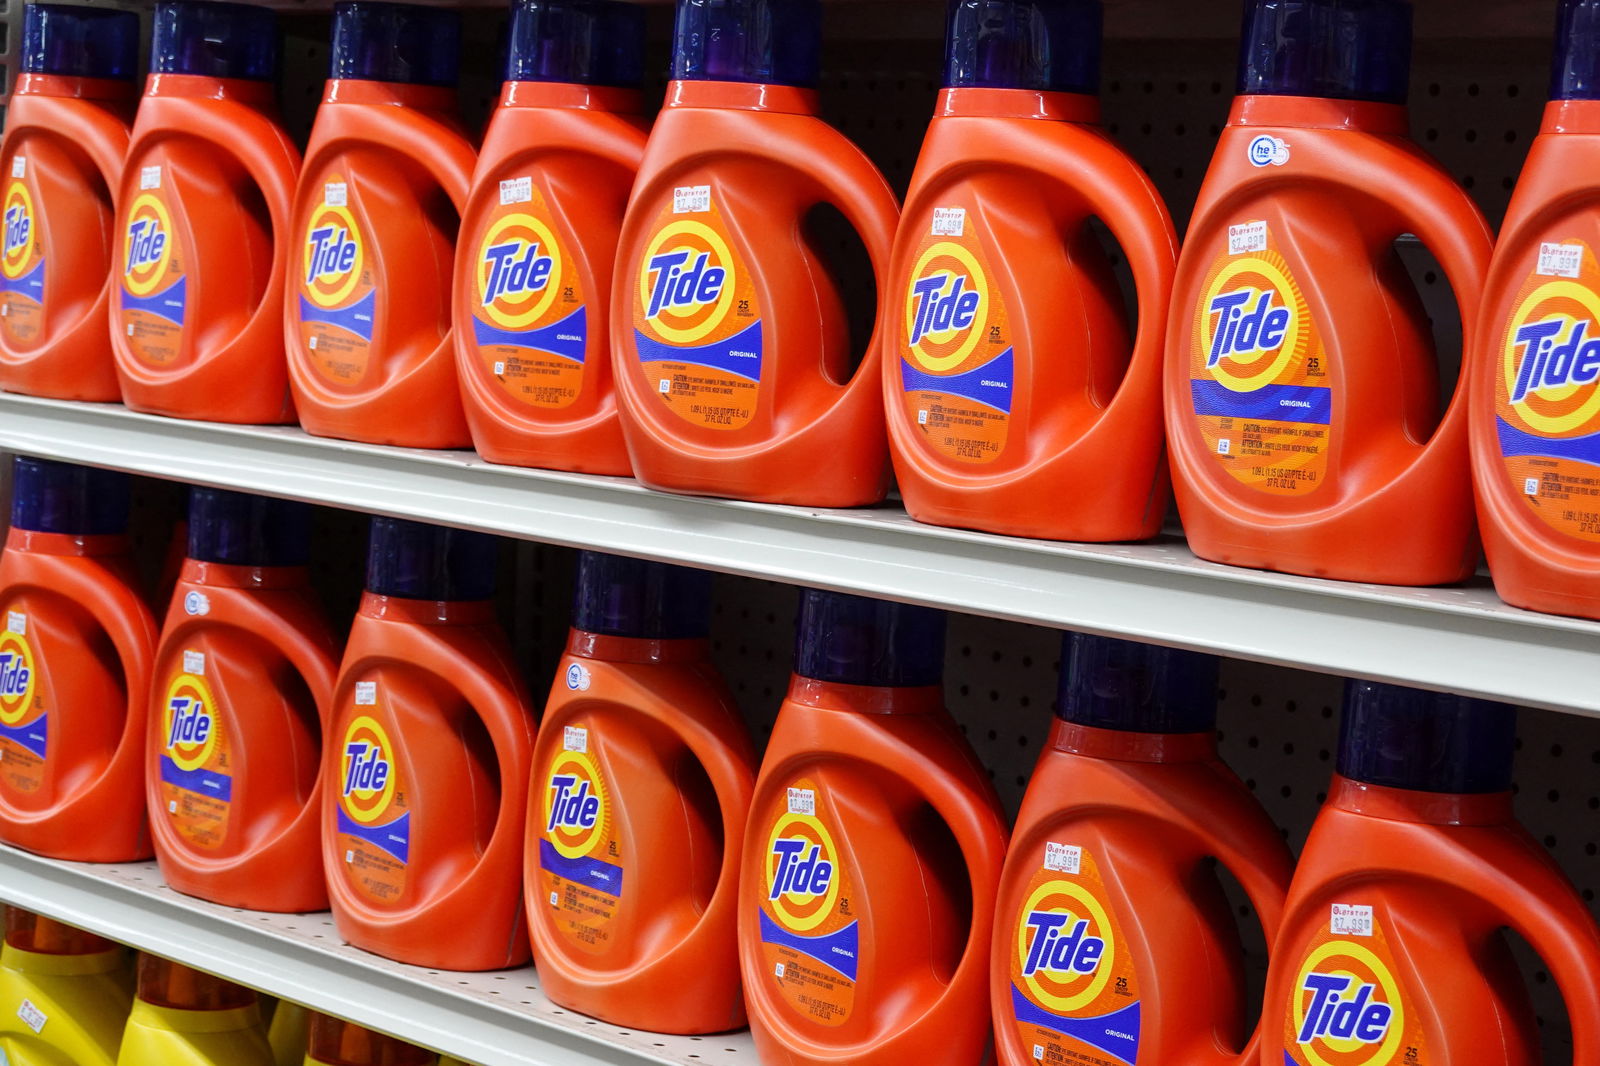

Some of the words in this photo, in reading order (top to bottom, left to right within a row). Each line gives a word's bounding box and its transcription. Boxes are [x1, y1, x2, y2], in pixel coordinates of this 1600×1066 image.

[2, 205, 30, 261] Tide
[125, 218, 165, 275] Tide
[306, 226, 356, 284] Tide
[482, 241, 552, 306] Tide
[564, 287, 573, 296] 25
[645, 250, 725, 319] Tide
[738, 300, 749, 309] 25
[909, 273, 979, 346] Tide
[990, 326, 1000, 336] 25
[1206, 288, 1288, 368] Tide
[729, 350, 758, 359] ORIGINAL
[1307, 357, 1319, 368] 25
[1509, 318, 1600, 404] Tide
[981, 380, 1008, 388] ORIGINAL
[1280, 399, 1311, 408] ORIGINAL
[0, 653, 29, 696] Tide
[167, 697, 210, 749] Tide
[343, 742, 388, 797] Tide
[547, 775, 599, 832] Tide
[769, 838, 832, 900] Tide
[832, 946, 854, 958] ORIGINAL
[1022, 910, 1104, 976] Tide
[1116, 976, 1127, 987] 25
[1296, 972, 1393, 1044] Tide
[1105, 1029, 1135, 1041] ORIGINAL
[1405, 1046, 1417, 1057] 25
